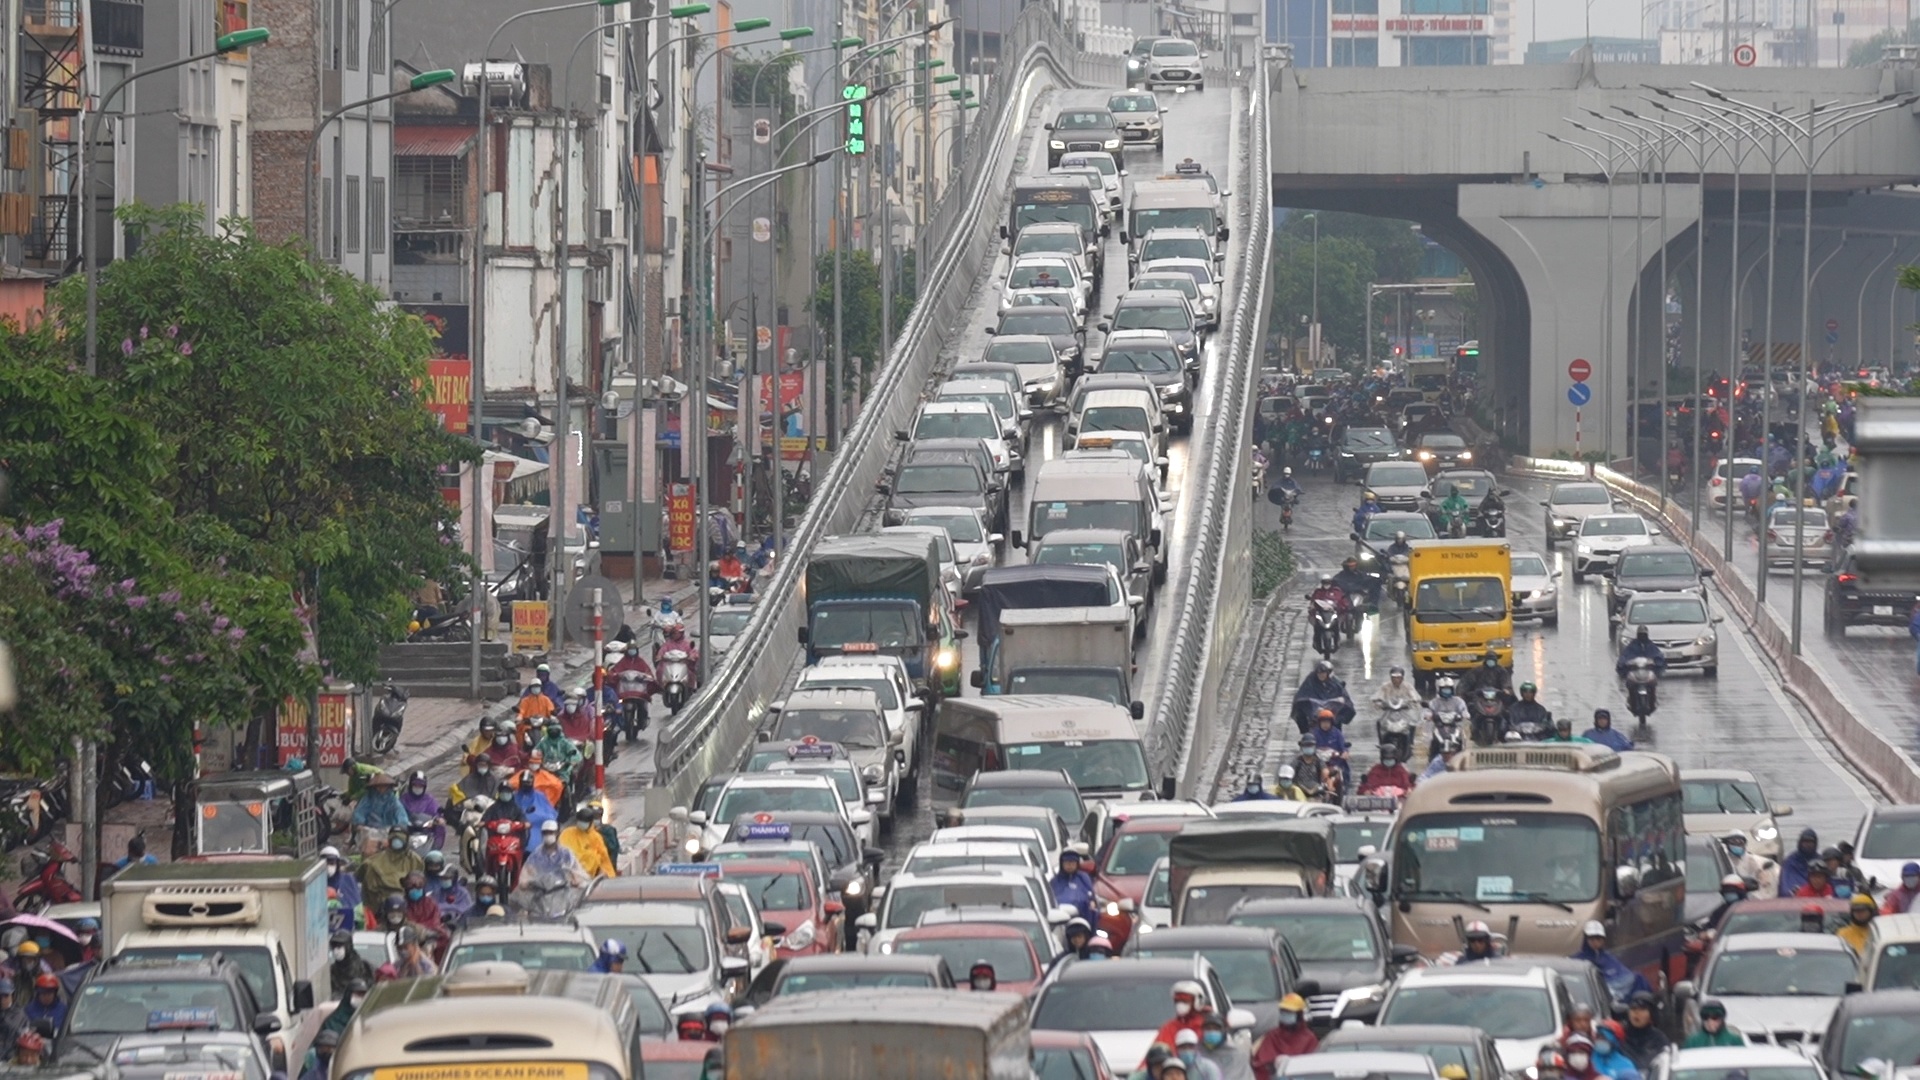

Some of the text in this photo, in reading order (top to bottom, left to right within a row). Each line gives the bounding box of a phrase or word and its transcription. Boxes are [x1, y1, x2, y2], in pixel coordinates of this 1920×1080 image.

[395, 1066, 565, 1080] VINHOMES OCEAN PARK
